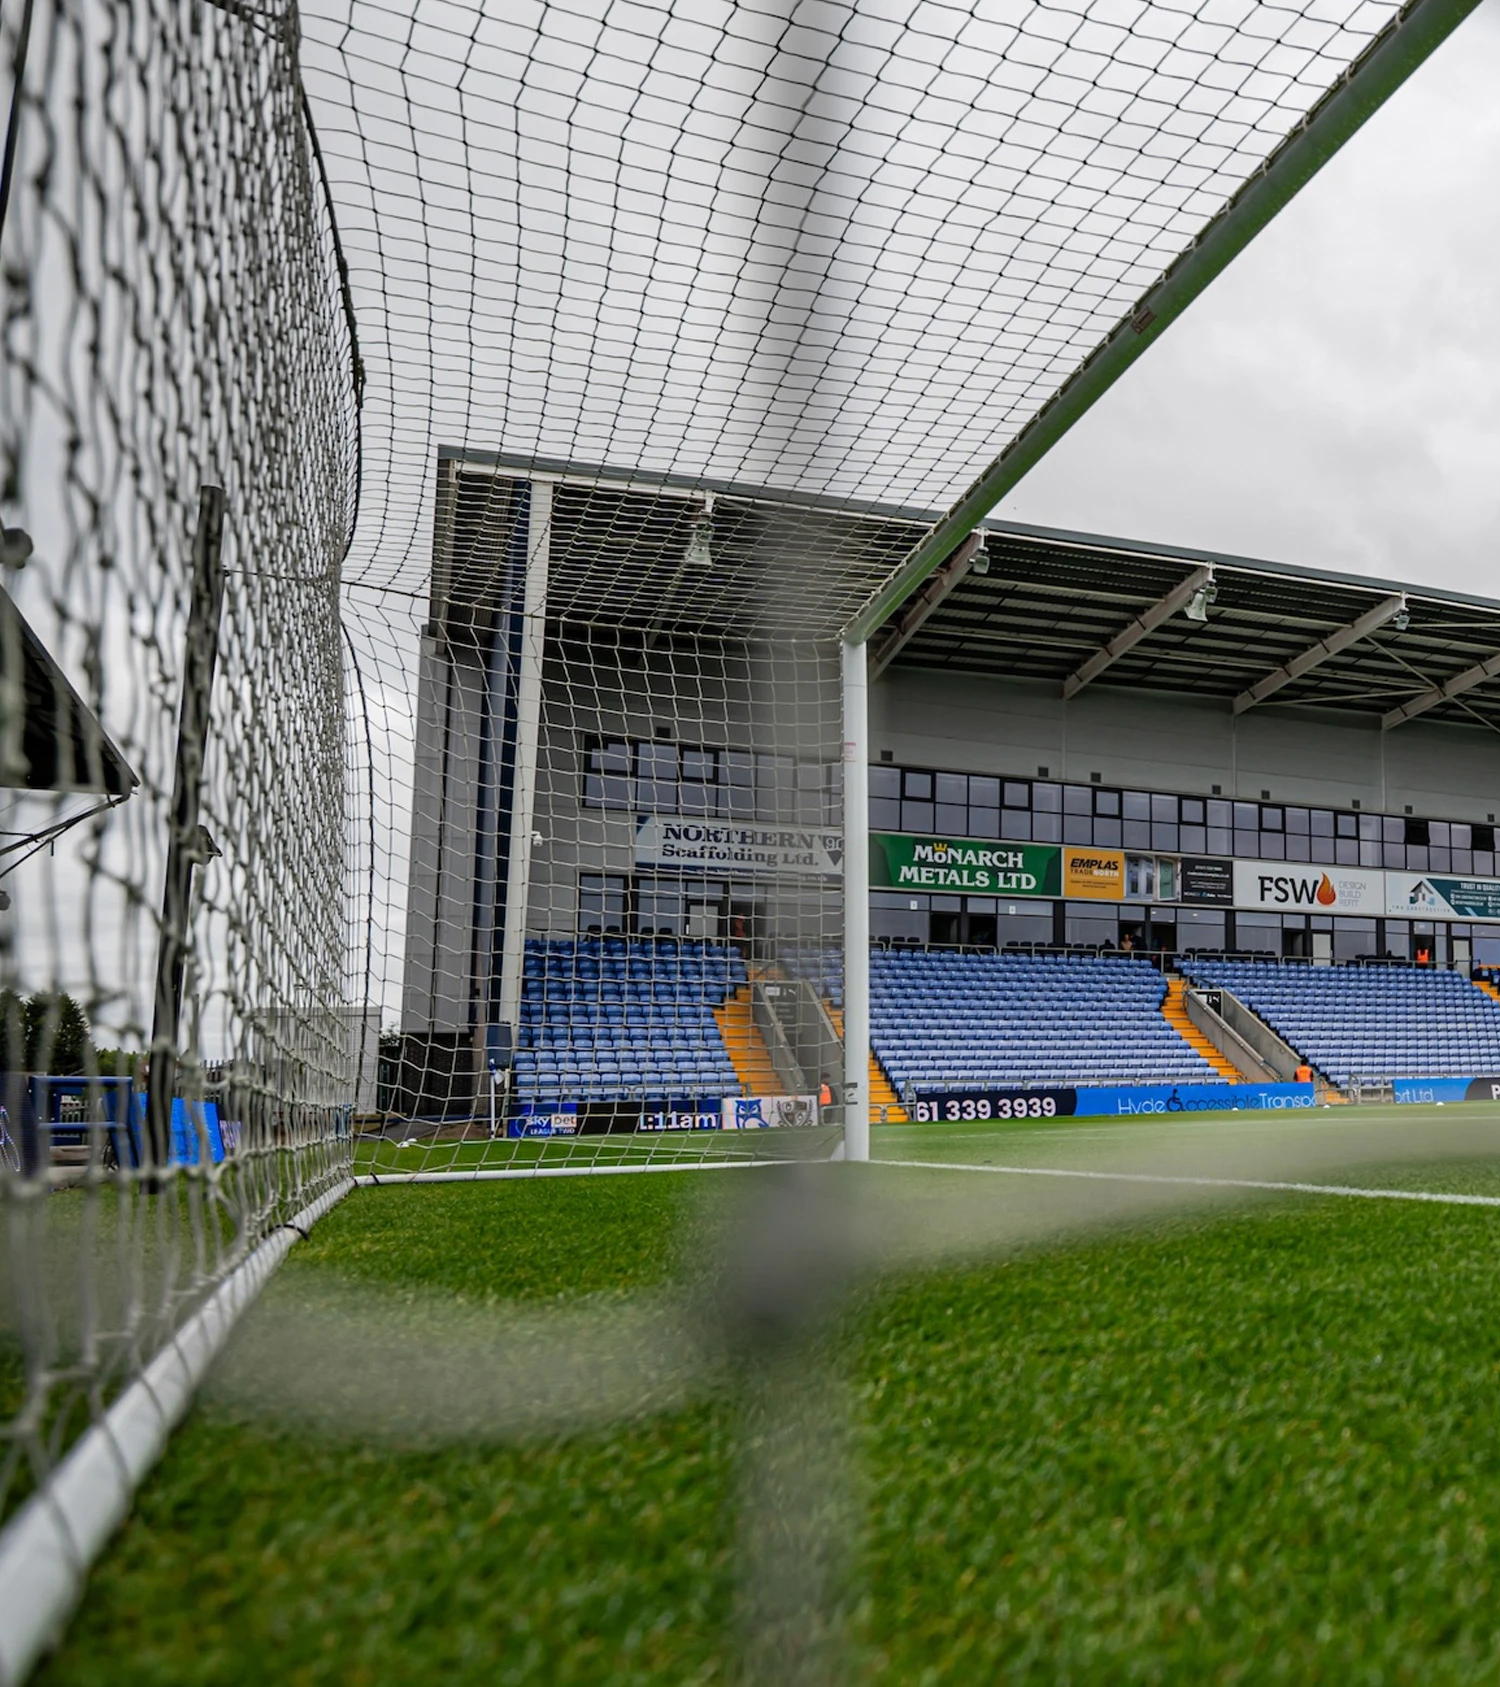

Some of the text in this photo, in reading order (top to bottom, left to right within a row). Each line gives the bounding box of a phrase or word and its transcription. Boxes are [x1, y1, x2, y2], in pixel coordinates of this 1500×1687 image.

[662, 823, 814, 849] NORTHERN
[662, 844, 818, 866] Scaffolding Ltd.
[1070, 858, 1119, 870] EMPLAS
[898, 866, 1037, 890] METALS LTD
[1258, 876, 1319, 904] FSW
[1118, 1098, 1166, 1114] Hyde
[1412, 1088, 1434, 1104] Ltd
[916, 1096, 1056, 1122] 61 339 3939
